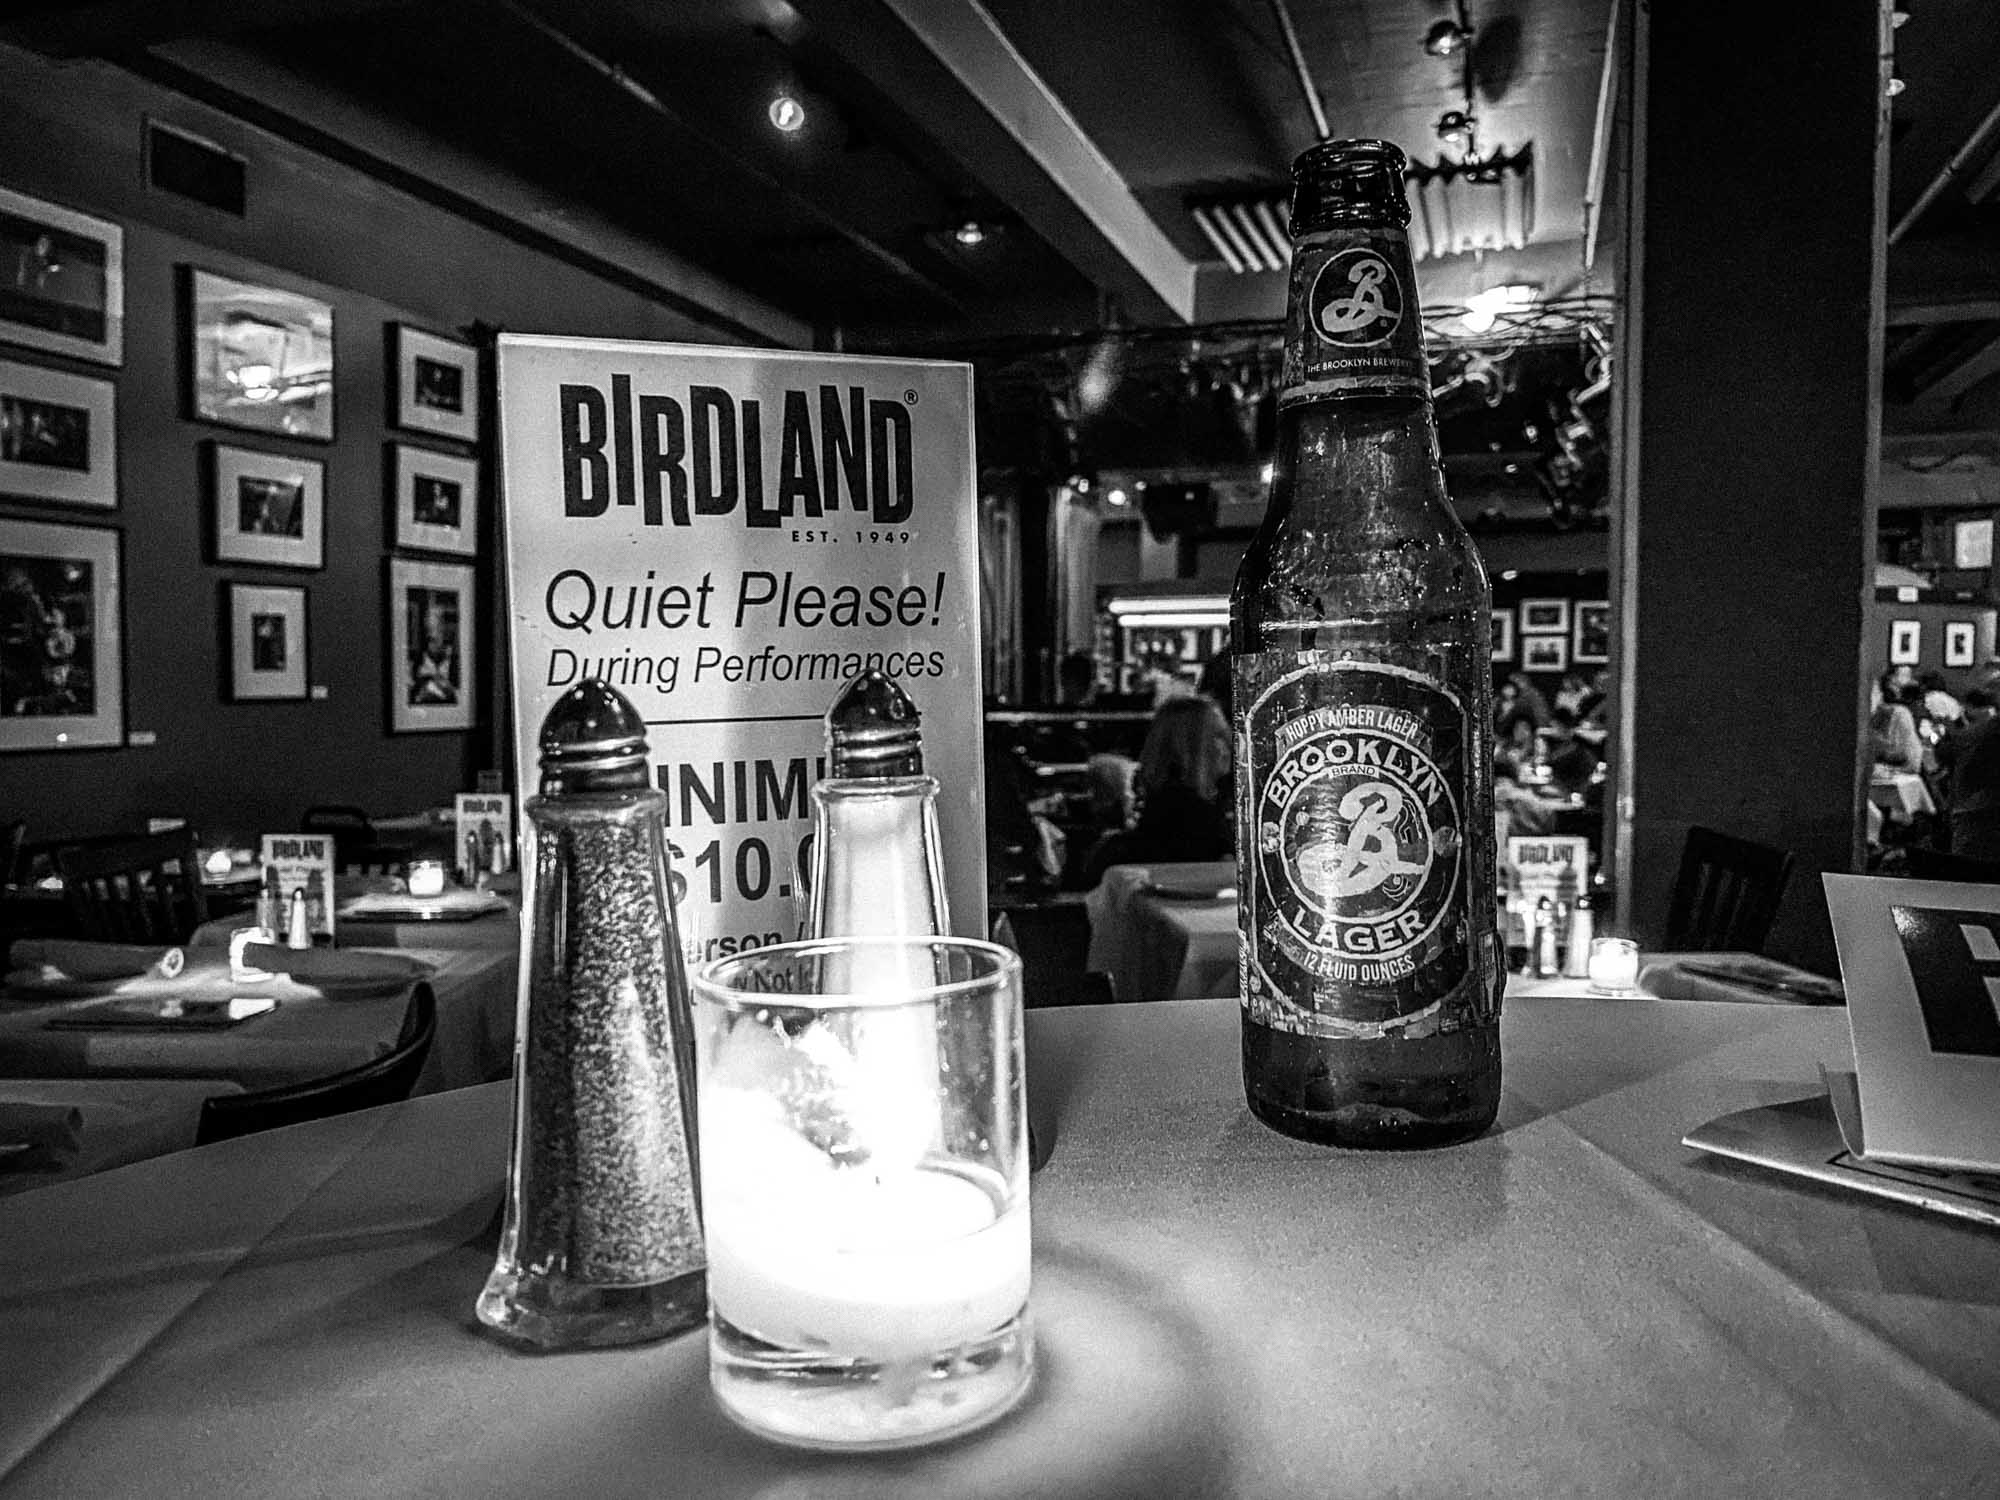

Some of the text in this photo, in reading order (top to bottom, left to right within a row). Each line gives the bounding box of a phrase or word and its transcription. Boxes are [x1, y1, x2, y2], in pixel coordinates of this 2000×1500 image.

[1307, 363, 1321, 373] THE
[1322, 358, 1371, 371] BROOKLYN
[791, 530, 911, 544] EST. 1949
[545, 569, 947, 635] Quiet Please!
[547, 645, 946, 694] During Performances
[1285, 709, 1419, 743] HOPPY AMBER LAGER
[1267, 738, 1444, 809] BROOKLYN
[1331, 766, 1377, 777] BRAND
[1292, 905, 1426, 951] LAGER
[1303, 952, 1416, 981] 12 FLUID OUNCES
